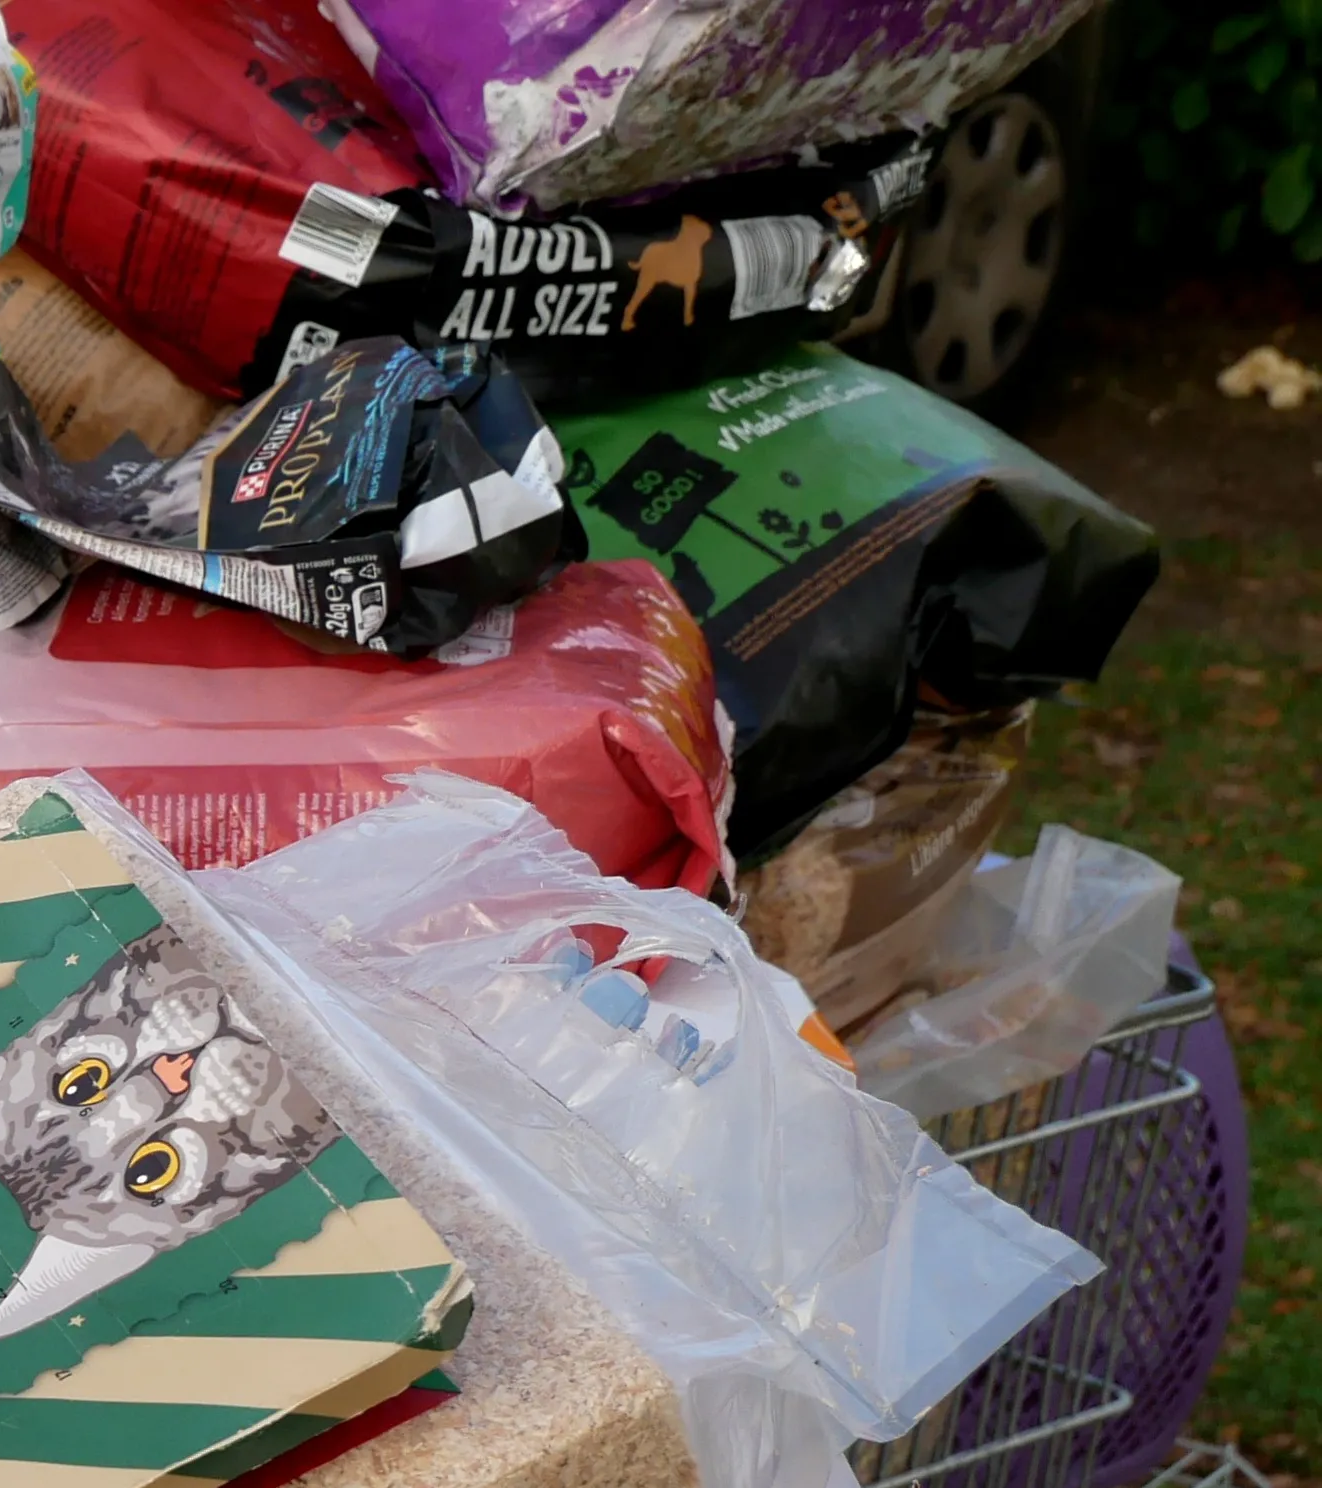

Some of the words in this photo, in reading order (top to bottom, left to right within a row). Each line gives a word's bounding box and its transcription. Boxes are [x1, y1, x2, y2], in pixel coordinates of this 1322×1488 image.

[440, 287, 515, 340] ALL
[526, 282, 617, 337] SIZE
[247, 406, 302, 474] PURINA
[734, 417, 787, 442] Made
[259, 452, 320, 533] PRO
[632, 470, 664, 496] SO
